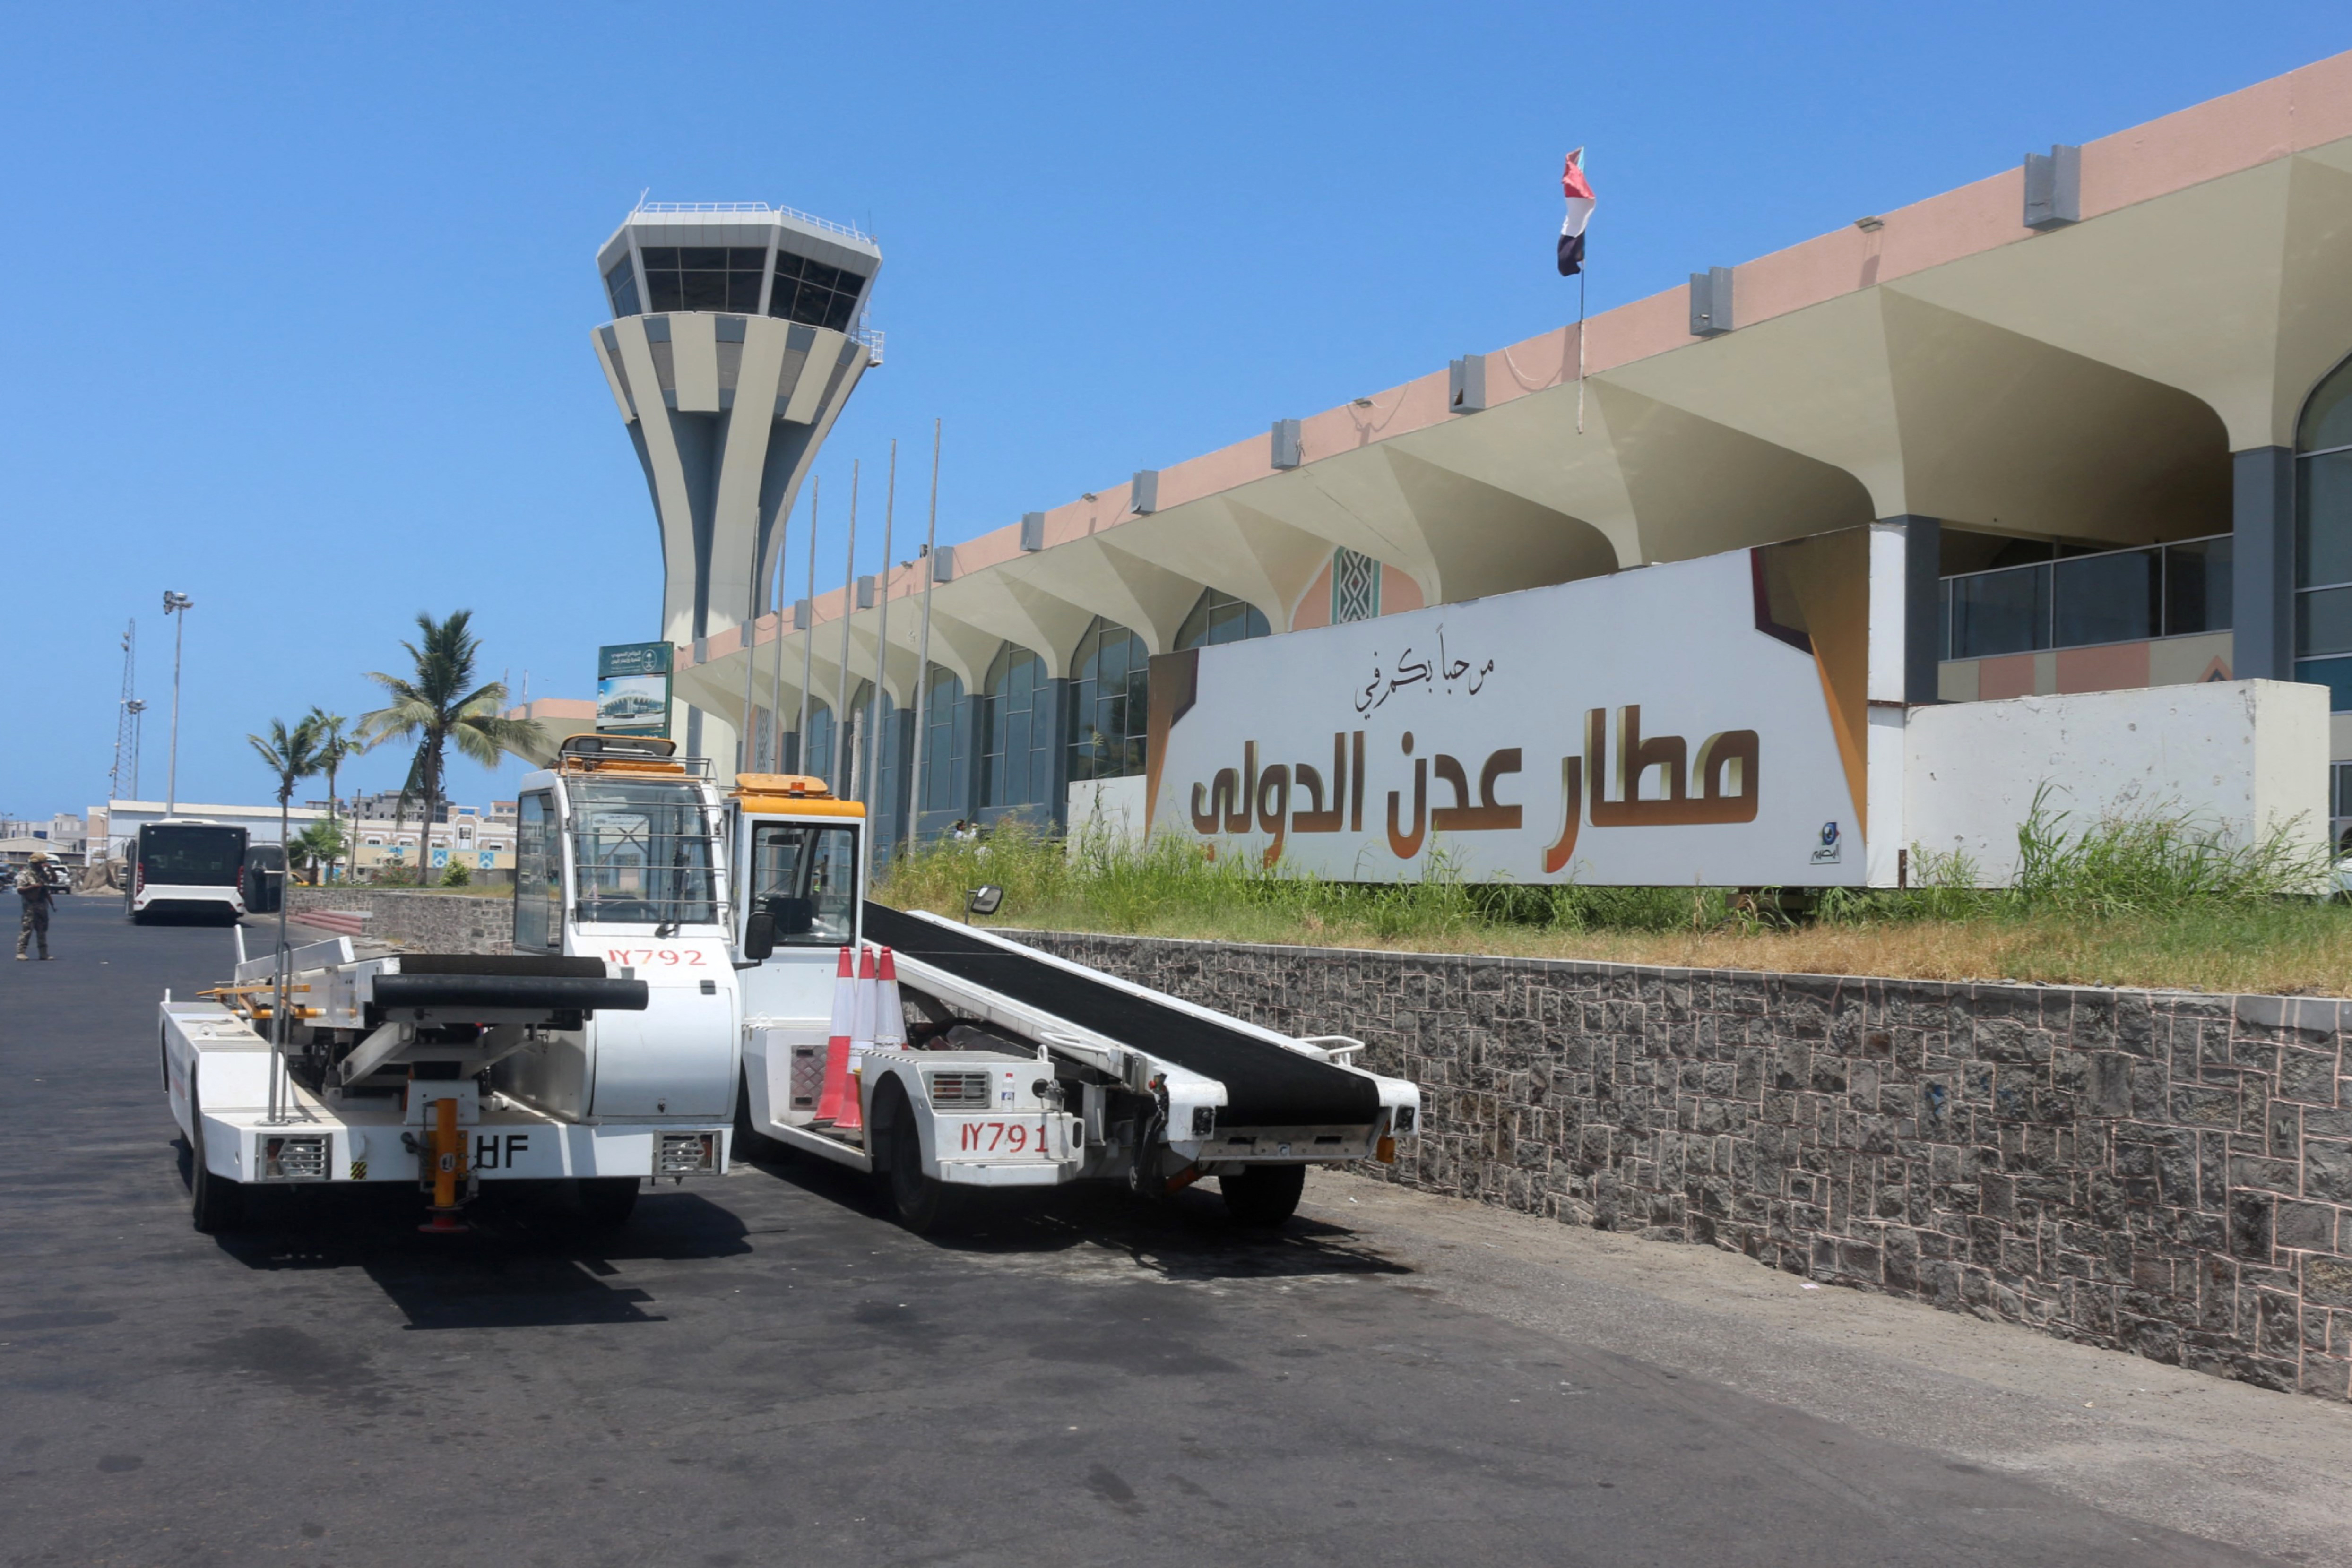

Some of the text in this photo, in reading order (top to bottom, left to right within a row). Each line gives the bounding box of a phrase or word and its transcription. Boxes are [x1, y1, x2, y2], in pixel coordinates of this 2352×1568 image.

[1355, 650, 1380, 720] في
[1373, 648, 1433, 709] بكم
[1387, 731, 1522, 860] عدن
[1541, 704, 1759, 874] مطار
[608, 949, 707, 965] IY792
[476, 1135, 528, 1168] HF
[962, 1122, 1049, 1153] IY791
